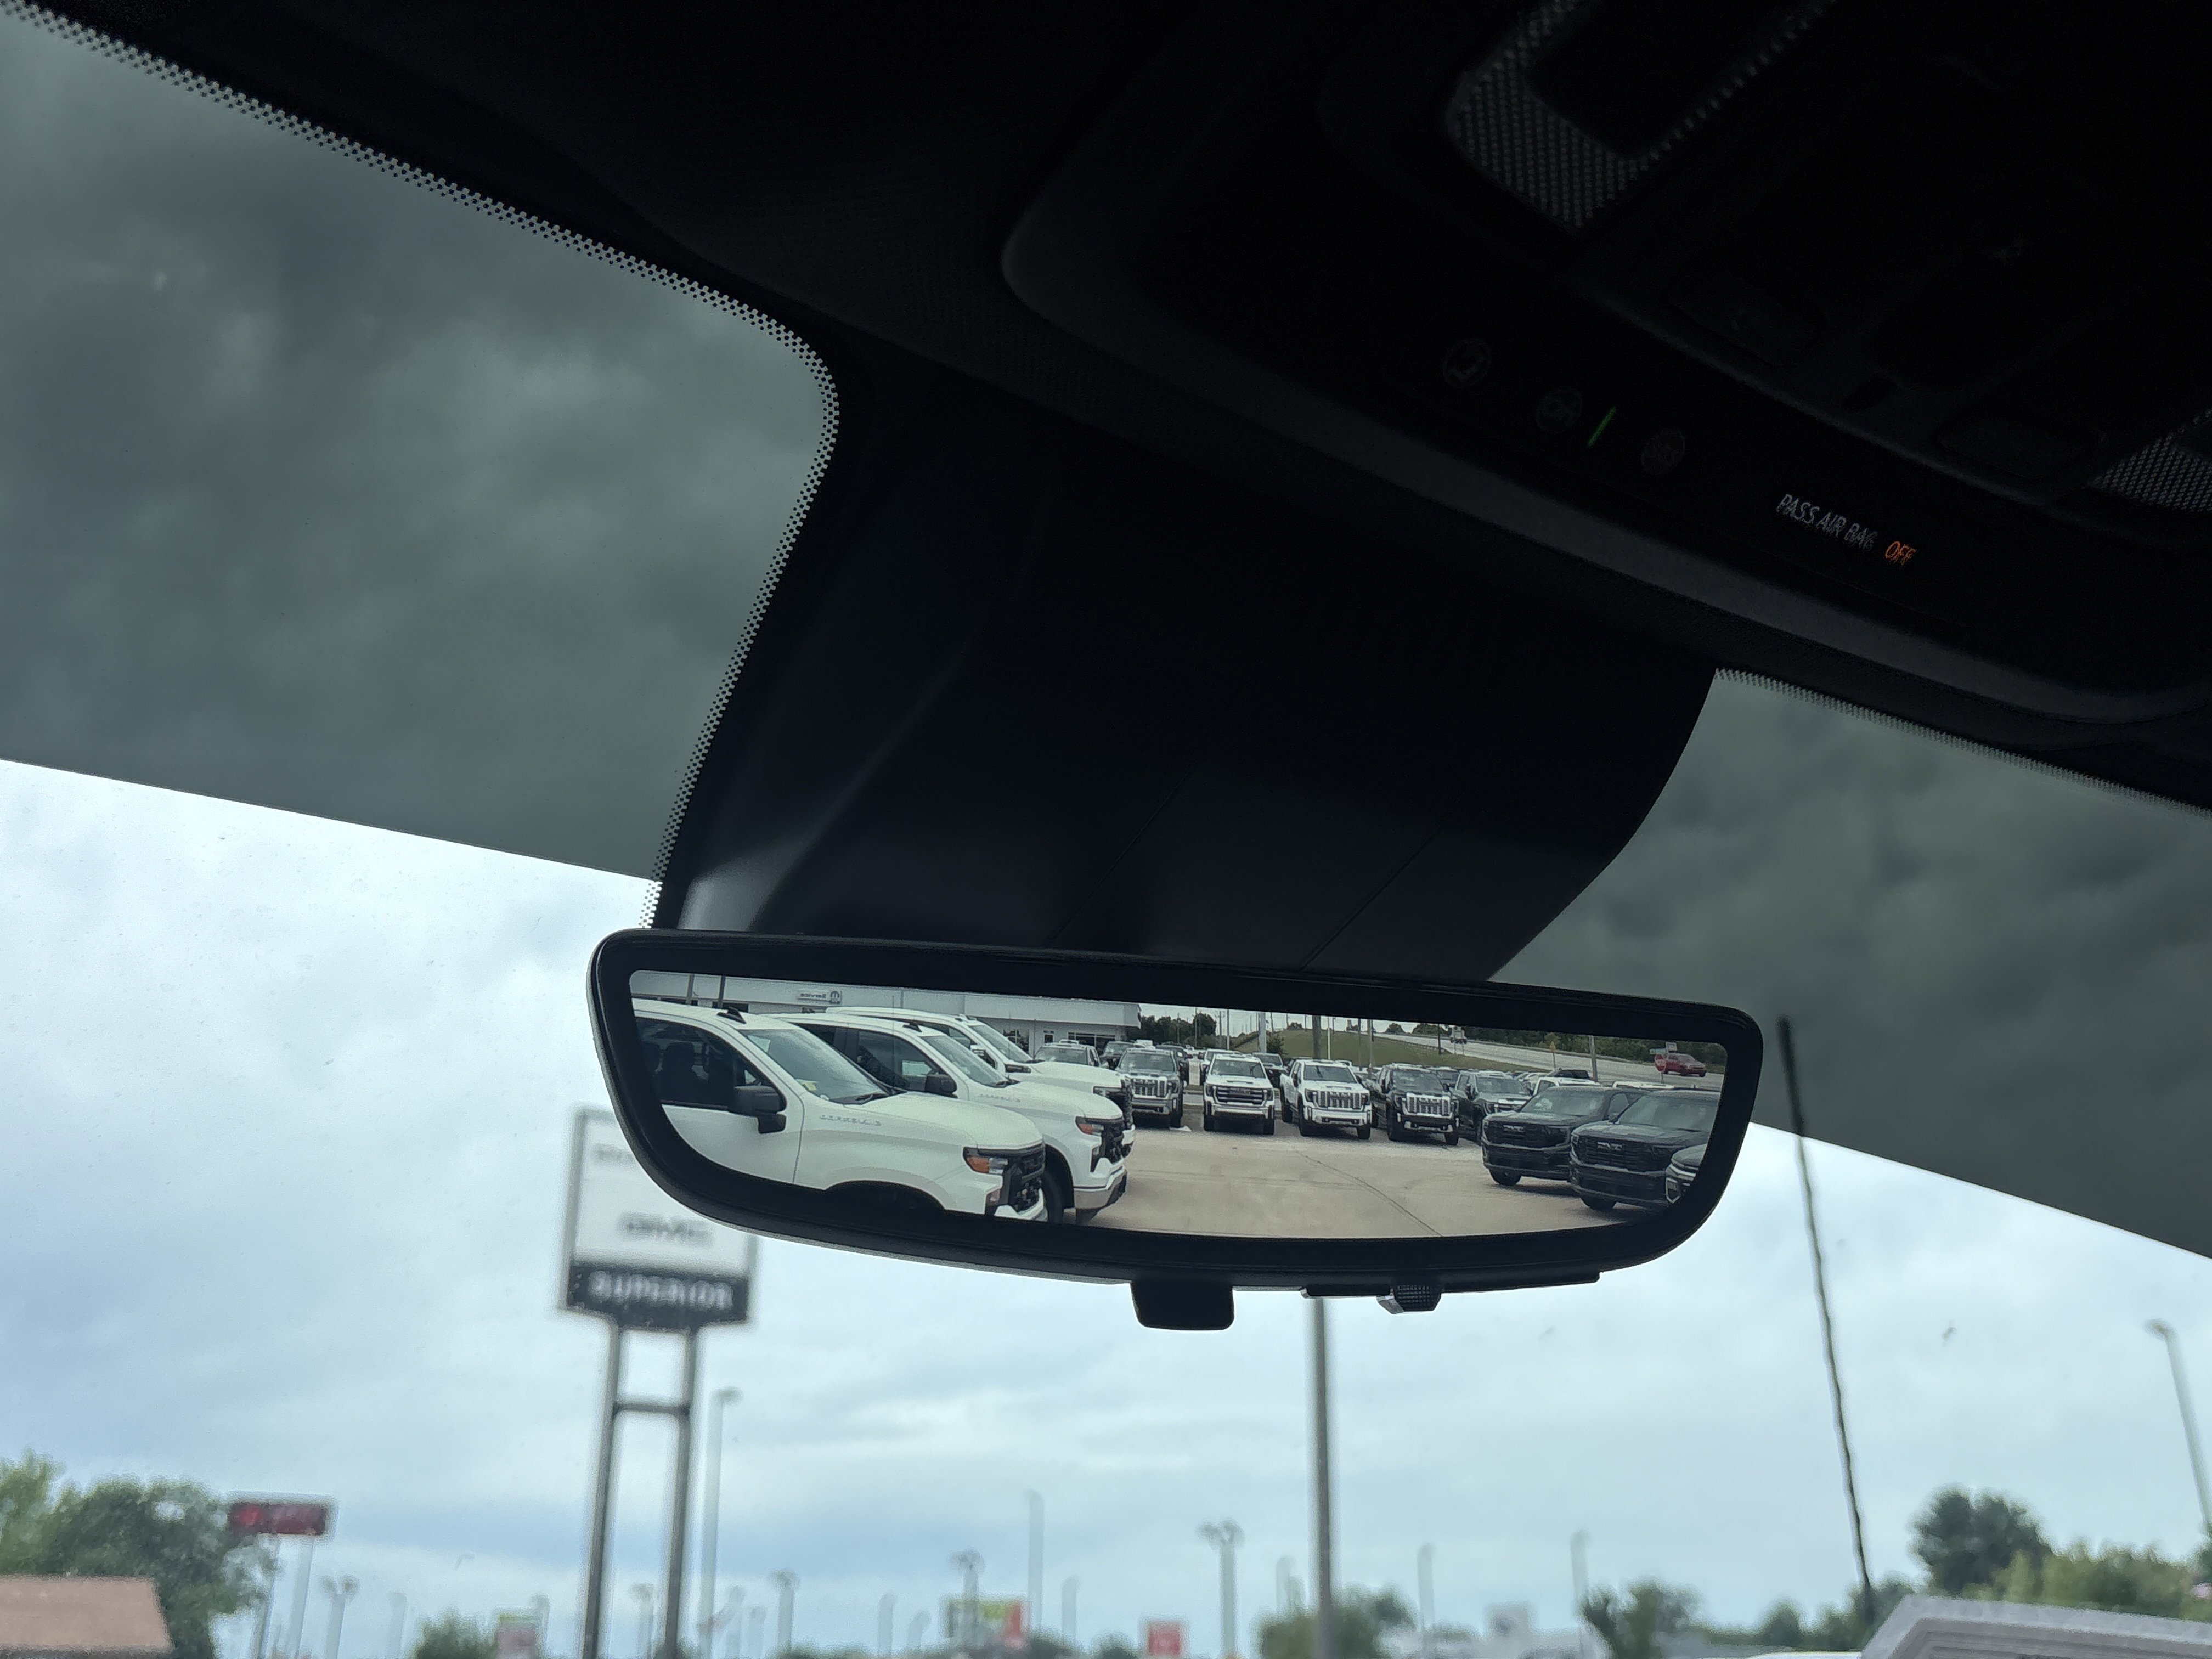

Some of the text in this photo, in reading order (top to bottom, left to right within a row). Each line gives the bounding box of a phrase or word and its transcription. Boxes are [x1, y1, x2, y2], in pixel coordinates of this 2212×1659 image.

[1776, 493, 1918, 566] PASS AIR BAG OFF
[588, 1270, 734, 1308] SUPERIOR
